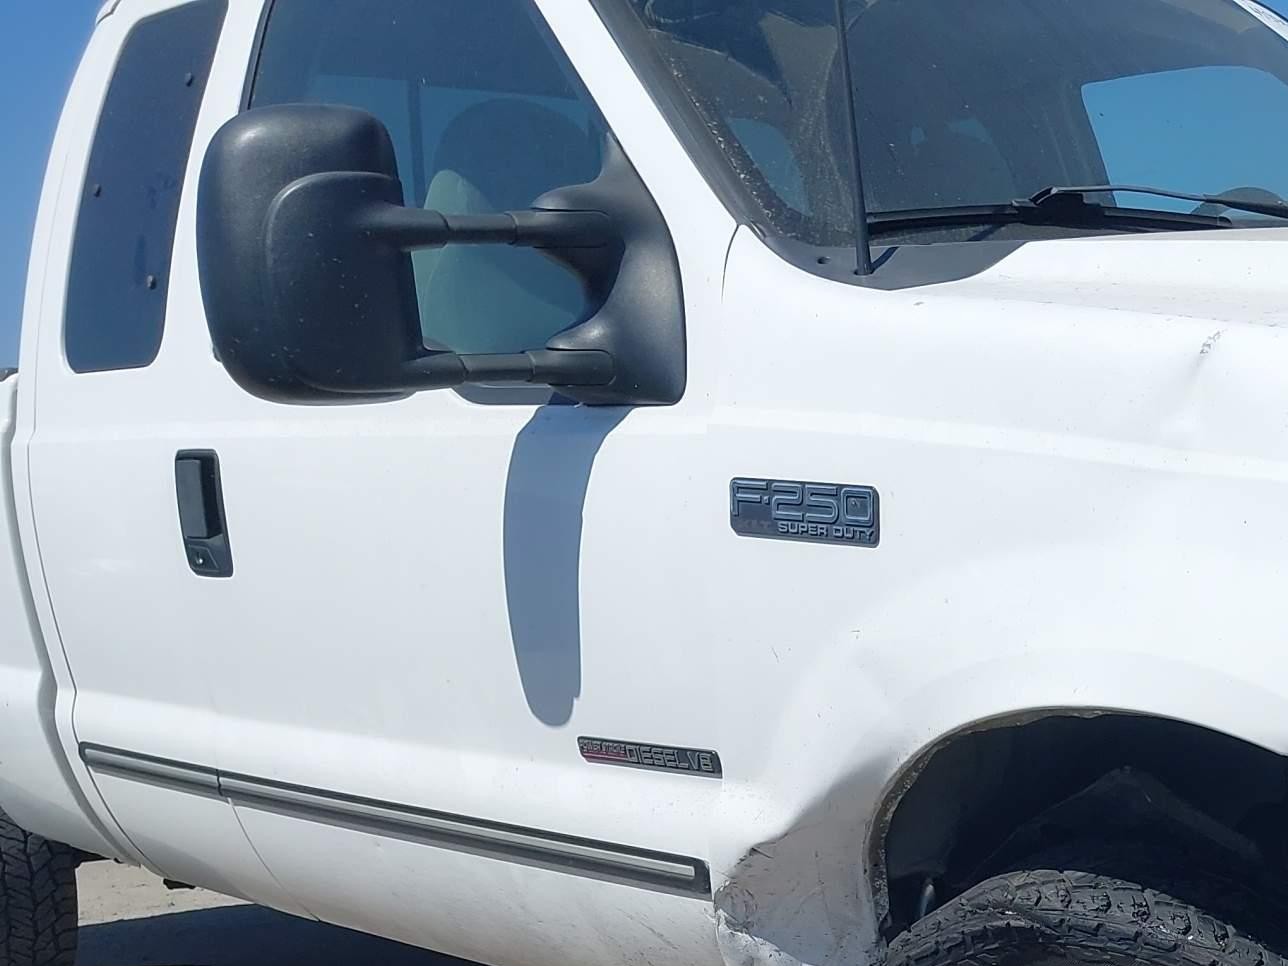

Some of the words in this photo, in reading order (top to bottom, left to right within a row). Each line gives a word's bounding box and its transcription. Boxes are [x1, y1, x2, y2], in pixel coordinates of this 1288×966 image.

[778, 521, 827, 538] SUPER
[832, 527, 874, 542] DUTY
[626, 745, 688, 767] DIESEL
[688, 751, 713, 771] V8
